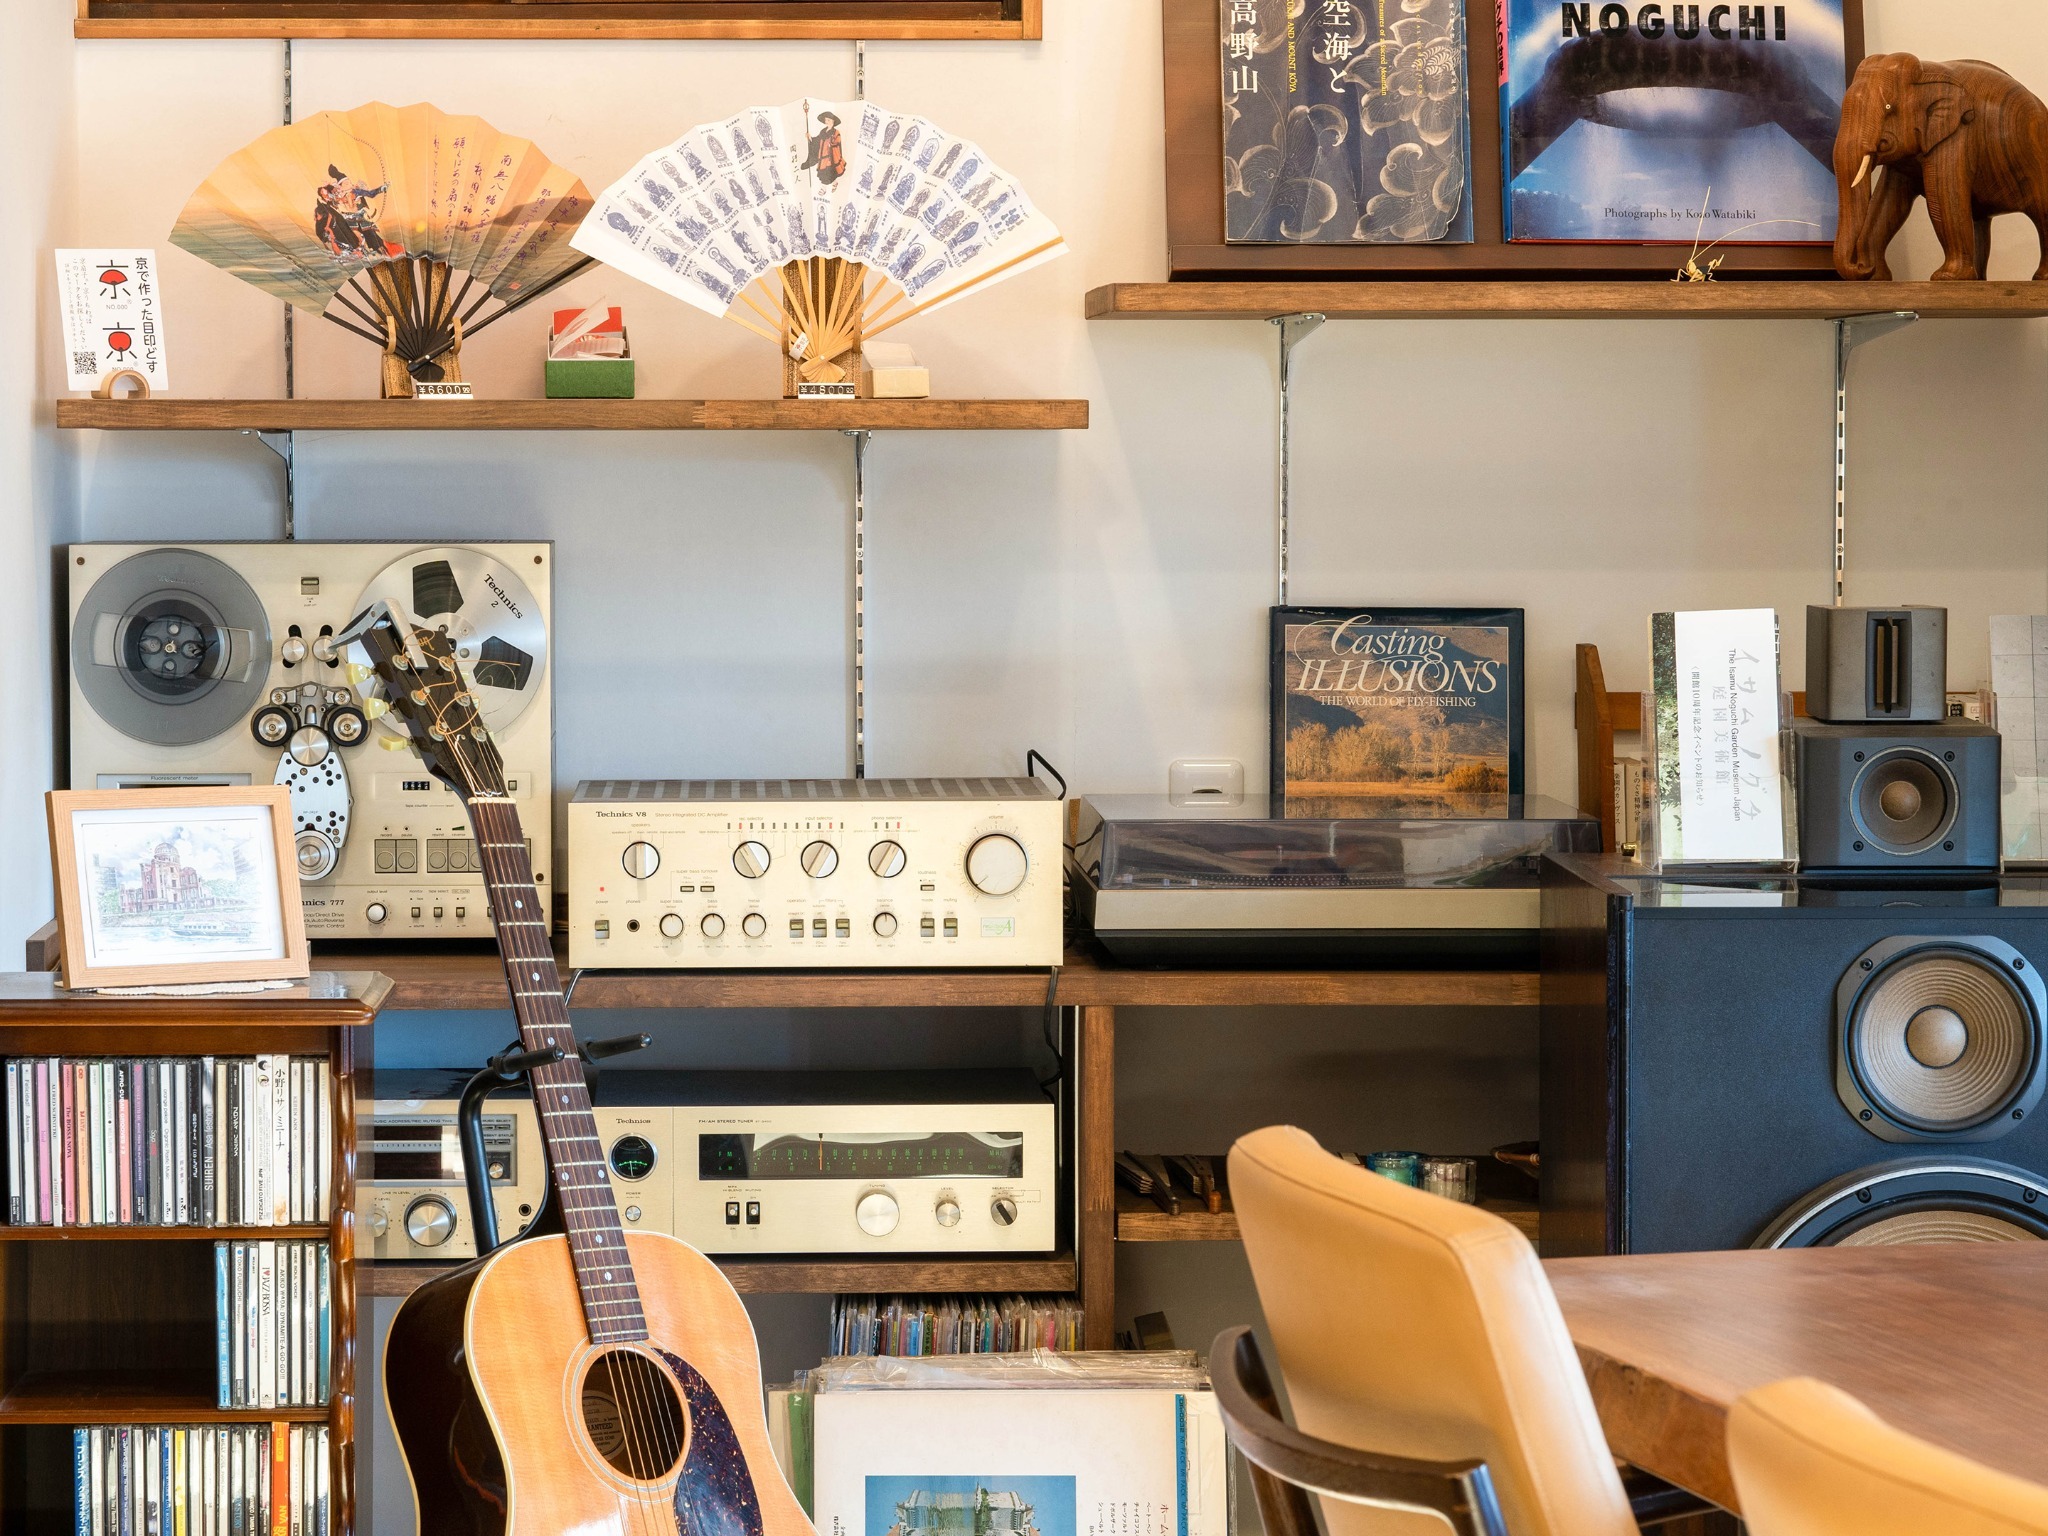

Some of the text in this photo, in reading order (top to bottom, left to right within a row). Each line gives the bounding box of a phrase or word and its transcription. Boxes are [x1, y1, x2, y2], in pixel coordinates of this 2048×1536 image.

[1287, 22, 1295, 38] AND
[1562, 2, 1787, 41] NOGUCHI
[1230, 0, 1259, 94] 高野山
[1288, 41, 1296, 70] MOUNT
[1322, 0, 1352, 94] 空海と
[1288, 72, 1298, 93] KŌYA
[1604, 207, 1668, 221] Photographs
[1670, 208, 1682, 221] by
[1711, 208, 1757, 220] Watabiki
[134, 257, 158, 373] 京で作った目印どす
[483, 573, 523, 619] Technics
[490, 600, 499, 608] 2
[1294, 614, 1446, 679] Casting
[1295, 658, 1501, 694] ILLUSIONS
[1320, 695, 1476, 708] THE WORLD OF FLY-FISHING
[1712, 686, 1731, 785] 庭園美術館
[1728, 649, 1742, 822] The Isamu Noguchi Garden Museum Japan
[1738, 648, 1769, 822] イサムノグチ
[595, 810, 648, 818] Technics V8
[330, 898, 345, 907] 777
[118, 1069, 126, 1112] AFRO-CUBAN
[162, 1129, 170, 1149] Organic
[205, 1134, 214, 1149] Asa
[205, 1156, 214, 1191] SUIREN
[262, 1275, 271, 1316] JAZZ BOSSA
[279, 1311, 287, 1380] DYNAMITE-A-GO-GO!!!
[279, 1505, 287, 1525] VAN
